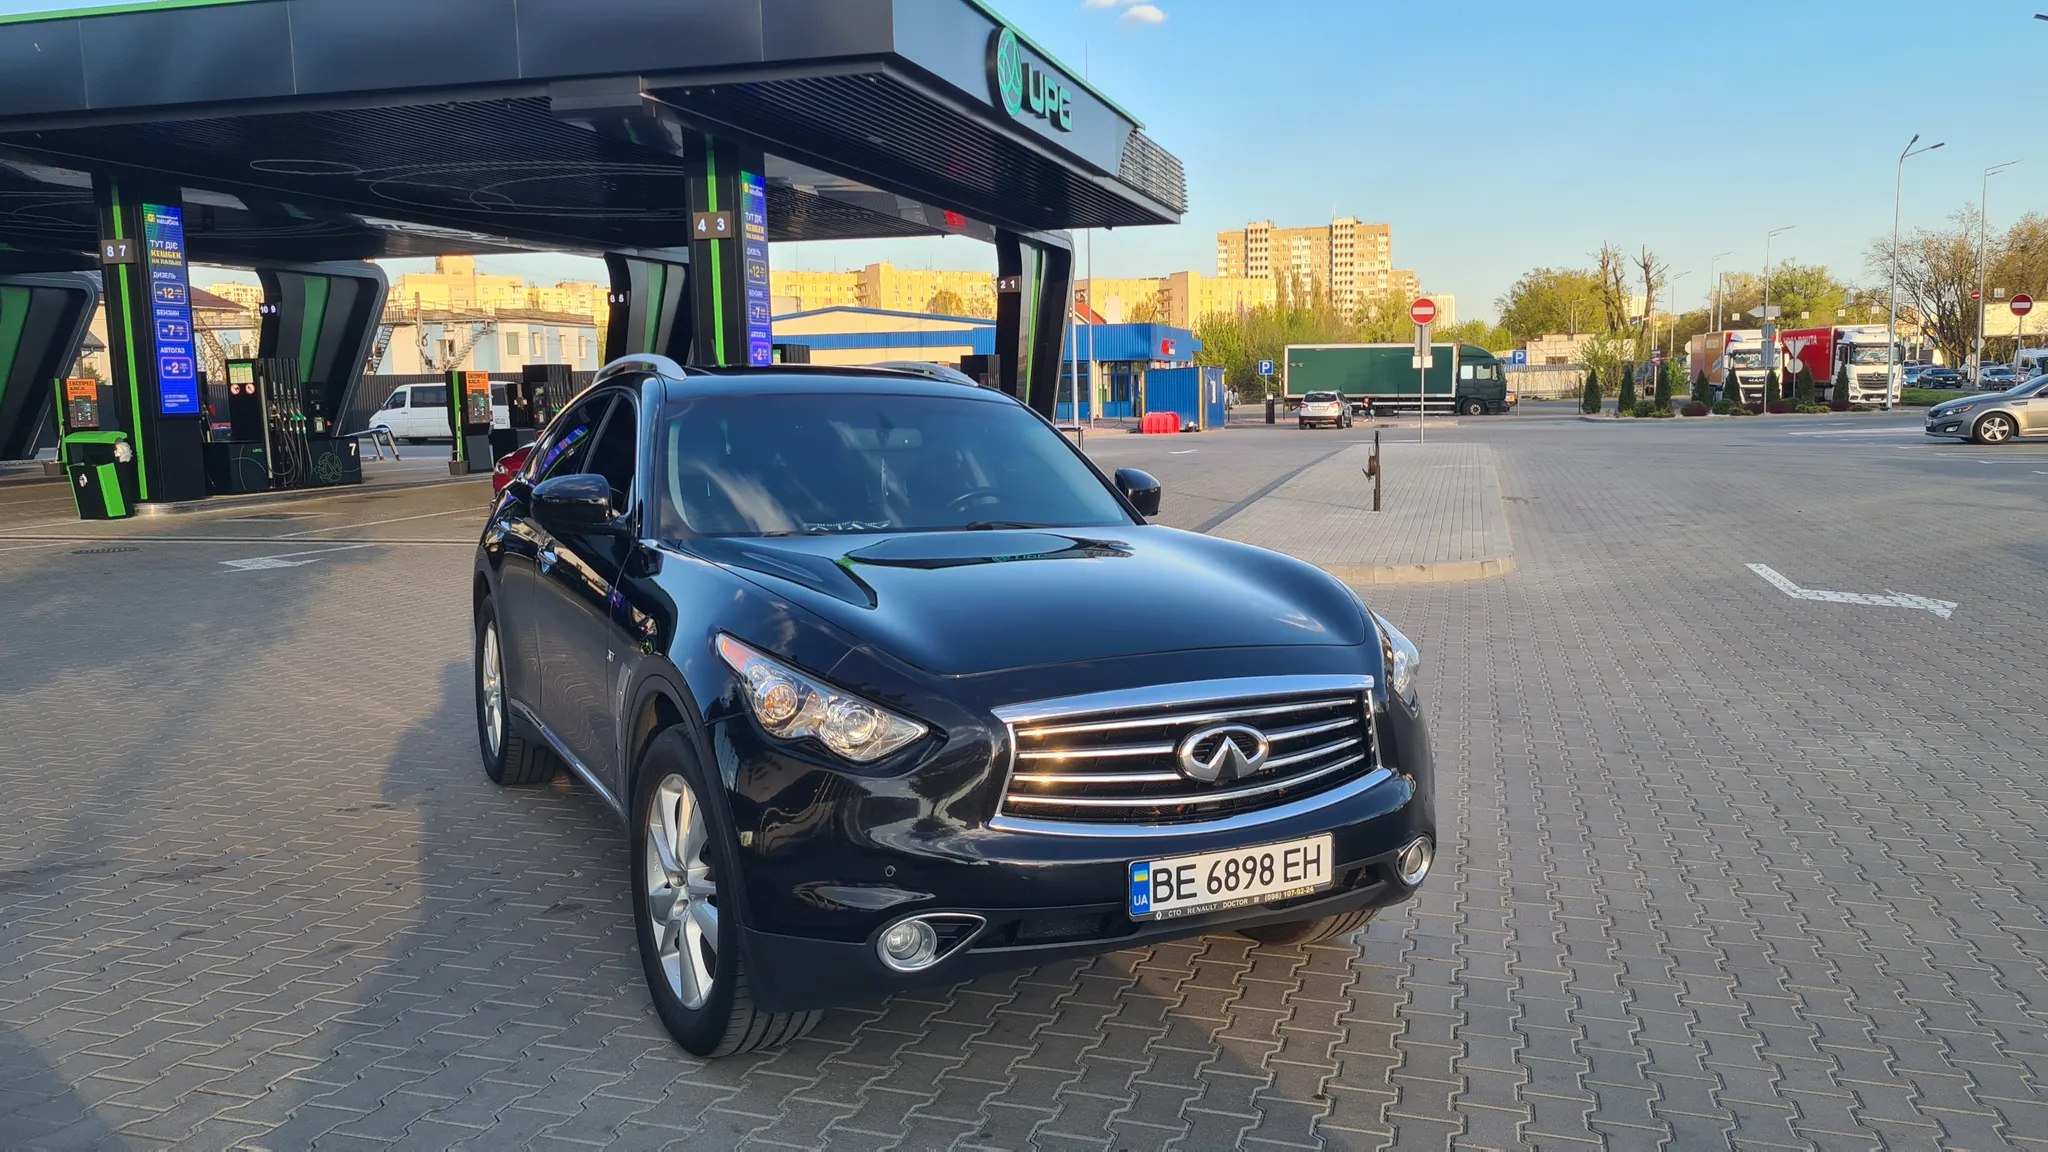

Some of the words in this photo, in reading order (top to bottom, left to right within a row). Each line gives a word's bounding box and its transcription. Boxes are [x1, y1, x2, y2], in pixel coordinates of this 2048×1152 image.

[1028, 63, 1073, 132] UPG
[698, 218, 707, 232] 4
[717, 217, 725, 231] 3
[107, 245, 114, 257] 8
[119, 244, 126, 257] 7
[150, 239, 164, 248] ТУТ
[165, 241, 179, 250] ДІЄ
[151, 249, 182, 259] КЕШБЕК
[153, 271, 177, 279] ДИЗЕЛЬ
[752, 265, 760, 278] 12
[1000, 279, 1006, 289] 2
[1010, 279, 1015, 289] 1
[162, 287, 175, 299] 12
[260, 304, 269, 314] 10
[755, 306, 760, 319] 7
[168, 324, 175, 336] 7
[160, 346, 185, 354] АВТОГАЗ
[757, 348, 763, 361] 2
[1515, 351, 1524, 364] P
[171, 362, 180, 374] 2
[1262, 361, 1270, 374] P
[349, 443, 357, 456] 7
[1152, 864, 1198, 904] BE
[1206, 853, 1275, 895] 6898
[1284, 844, 1321, 883] EH
[1133, 893, 1149, 907] UA
[1187, 903, 1218, 915] RENAULT
[1222, 898, 1249, 909] DOCTOR
